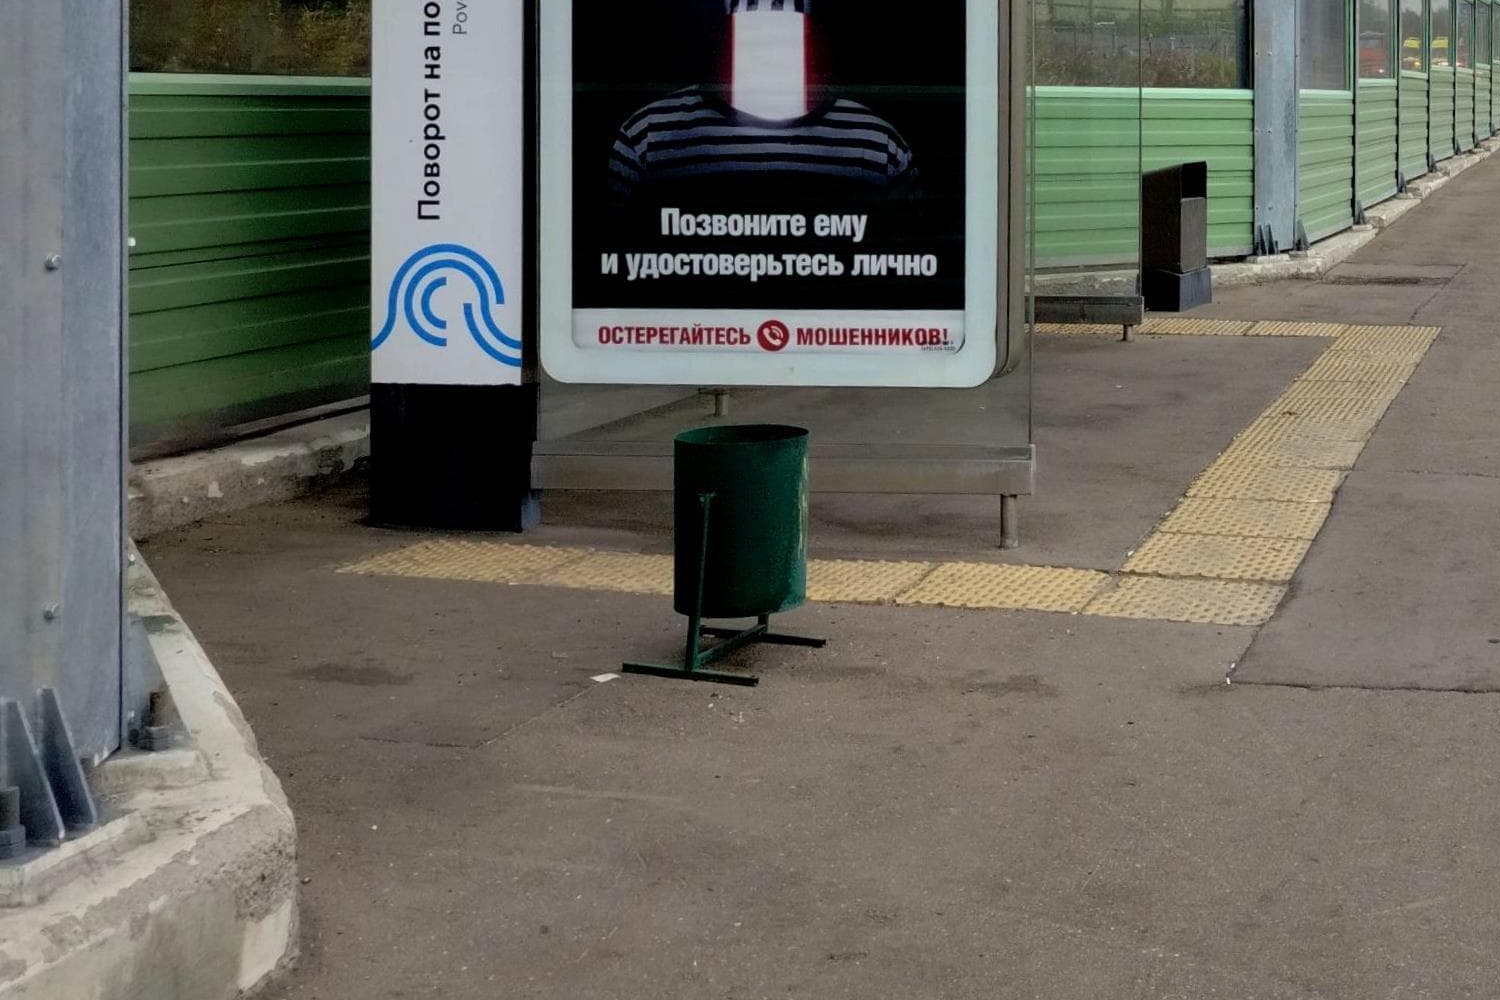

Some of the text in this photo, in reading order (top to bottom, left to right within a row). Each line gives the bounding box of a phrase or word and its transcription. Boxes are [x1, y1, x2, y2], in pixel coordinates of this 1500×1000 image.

[424, 46, 441, 79] на
[417, 88, 446, 220] Поворот
[660, 207, 868, 242] Позвоните ему
[601, 252, 938, 282] и удостоверьтесь лично
[598, 323, 752, 346] ОСТЕРЕГАЙТЕСЬ
[796, 327, 949, 347] МОШЕННИКОВ!
